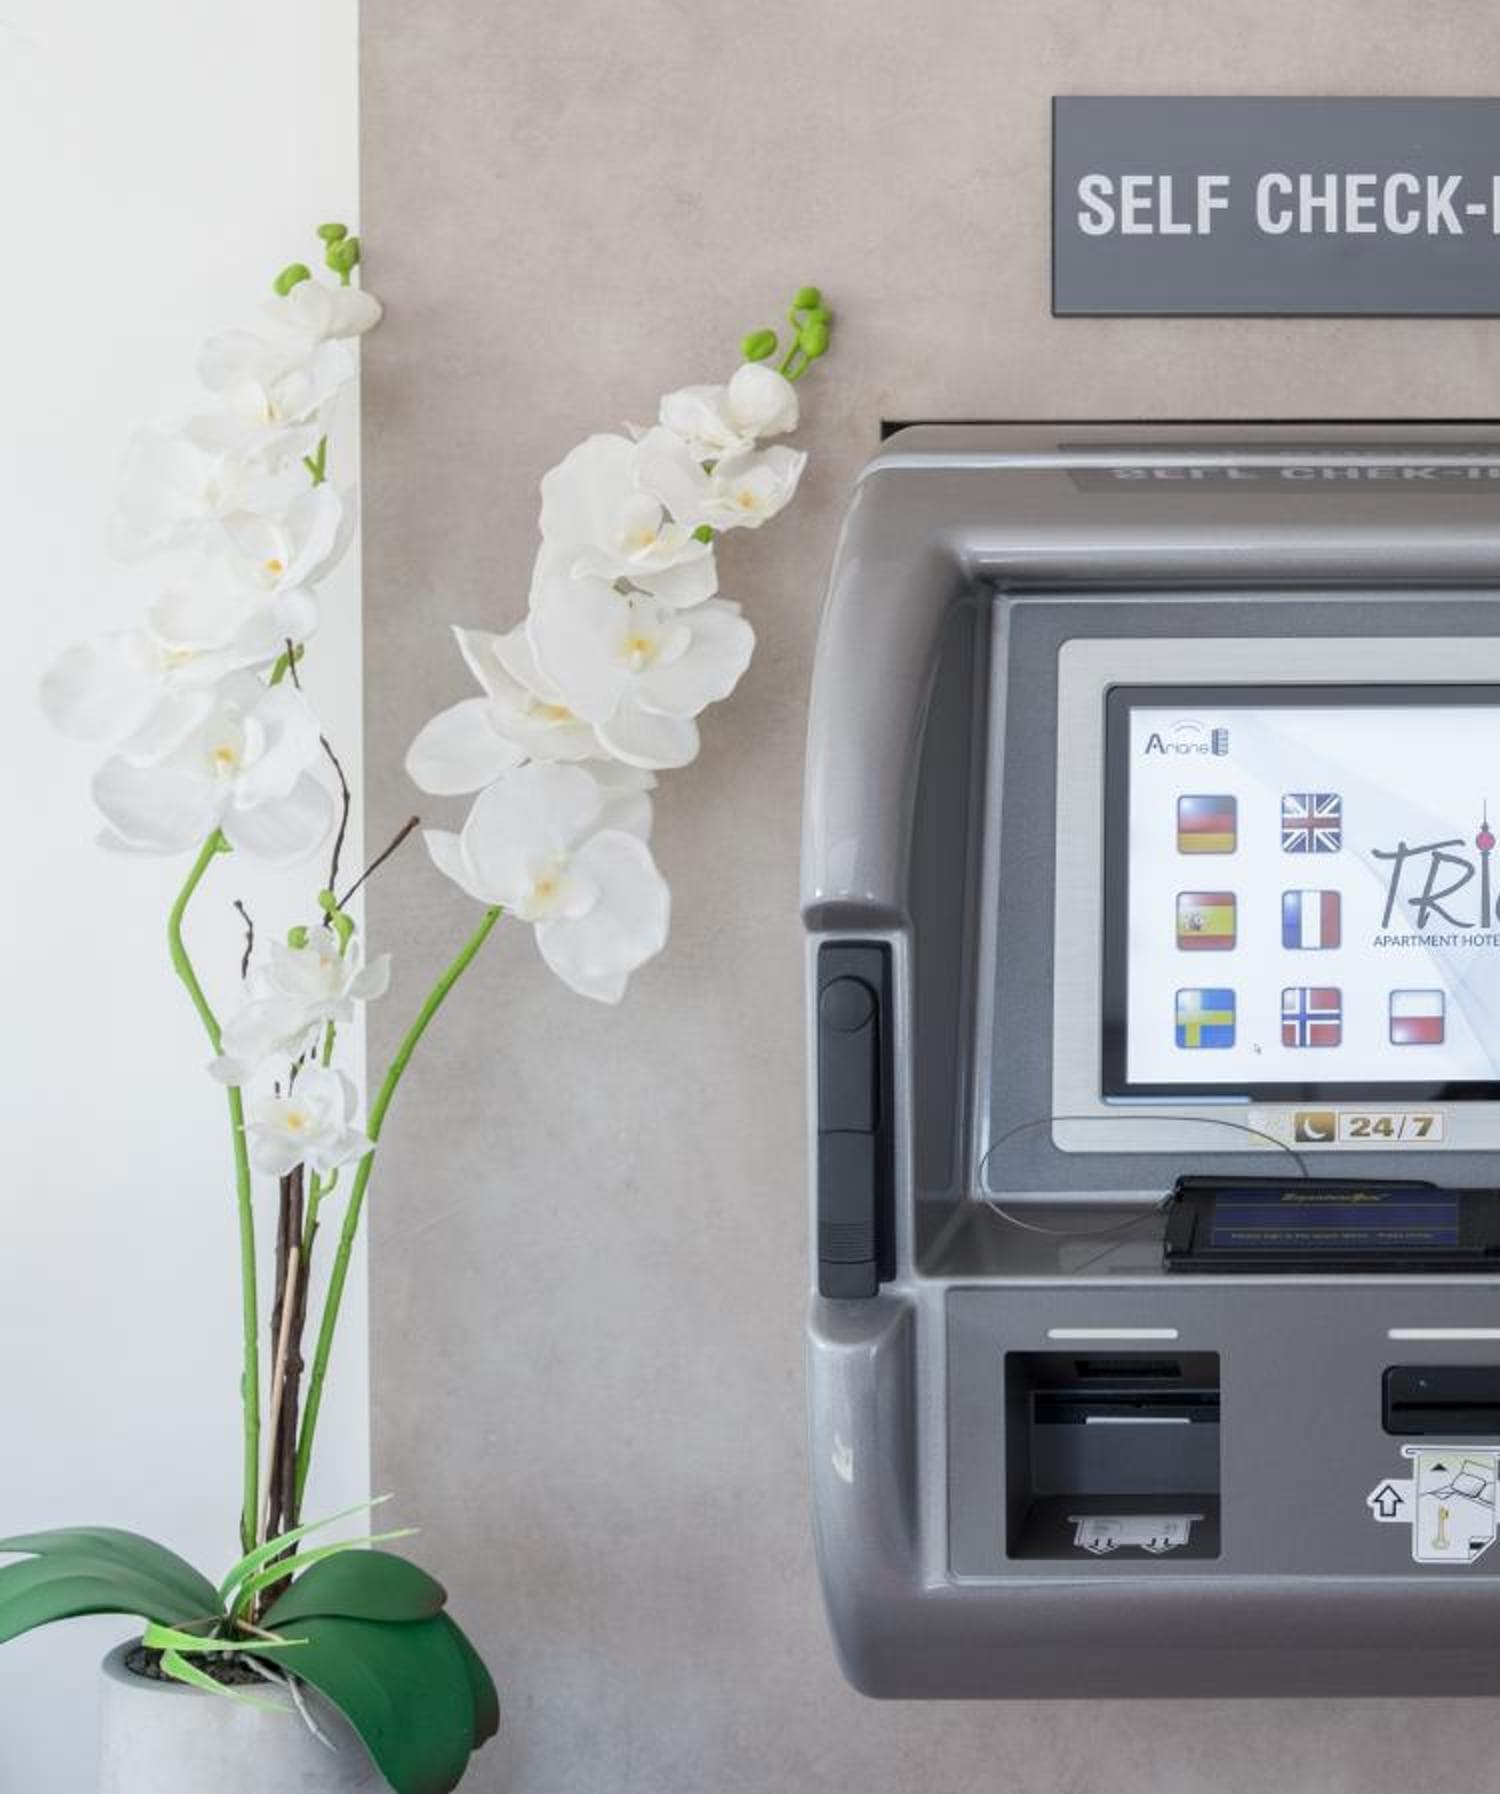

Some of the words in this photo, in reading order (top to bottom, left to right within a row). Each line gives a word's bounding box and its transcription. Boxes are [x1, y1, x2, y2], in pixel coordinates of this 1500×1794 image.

[1077, 173, 1231, 236] SELF
[1373, 934, 1459, 948] APARTMENT
[1348, 1115, 1436, 1139] 24/7
